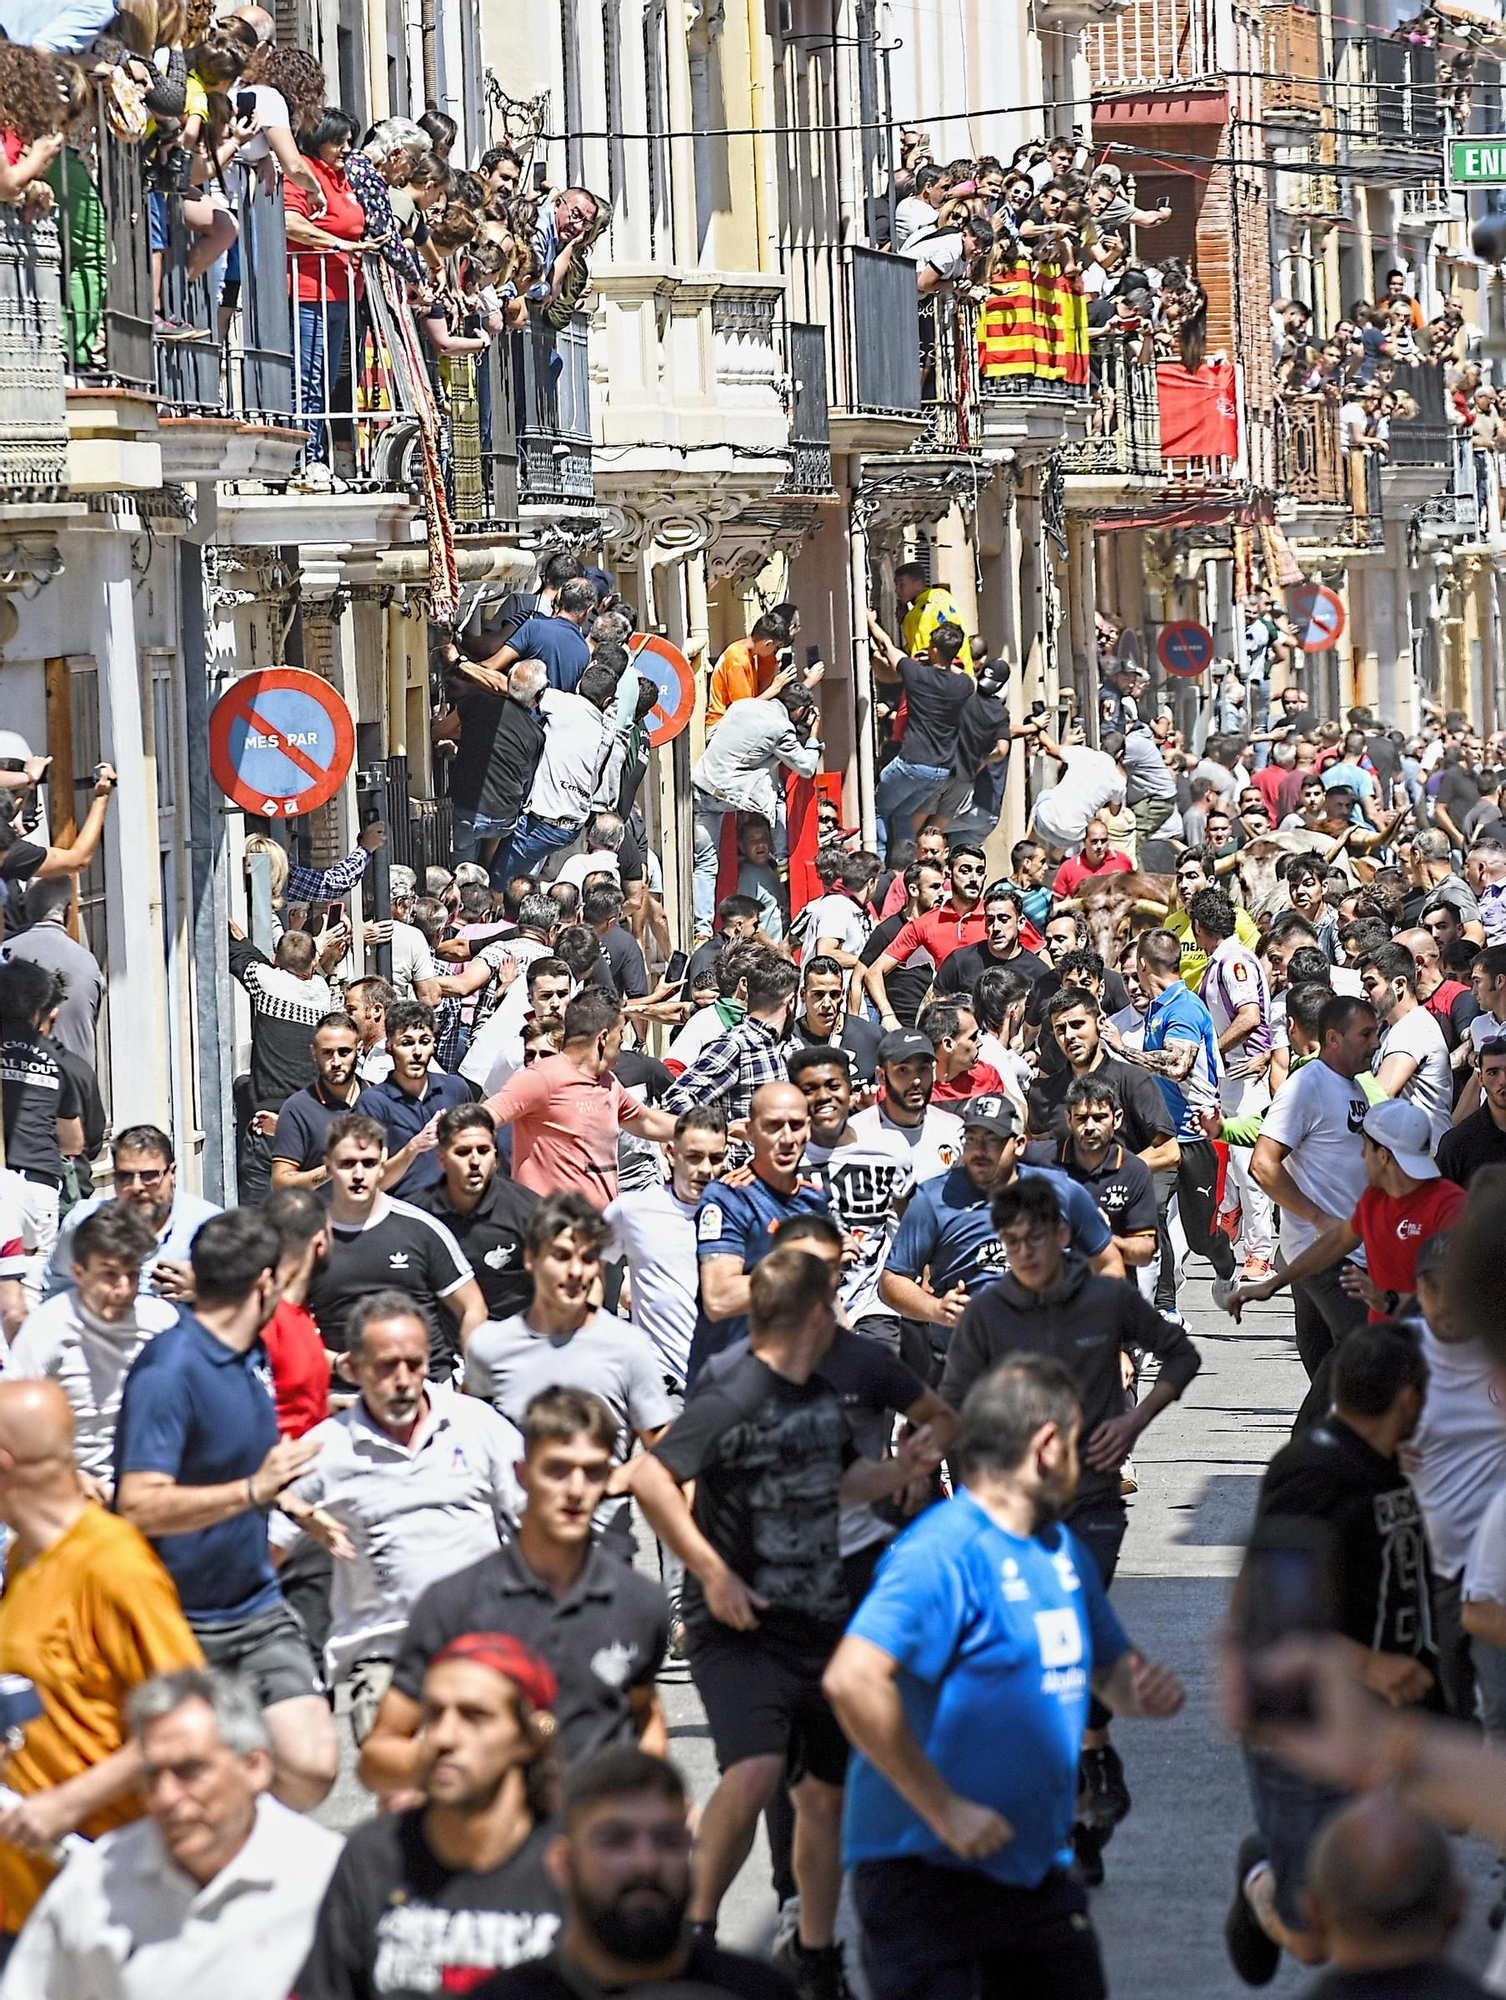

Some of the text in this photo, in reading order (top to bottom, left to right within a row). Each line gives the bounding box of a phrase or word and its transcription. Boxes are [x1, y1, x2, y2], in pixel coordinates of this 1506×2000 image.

[1465, 148, 1506, 175] EN
[244, 732, 318, 750] MES PAR
